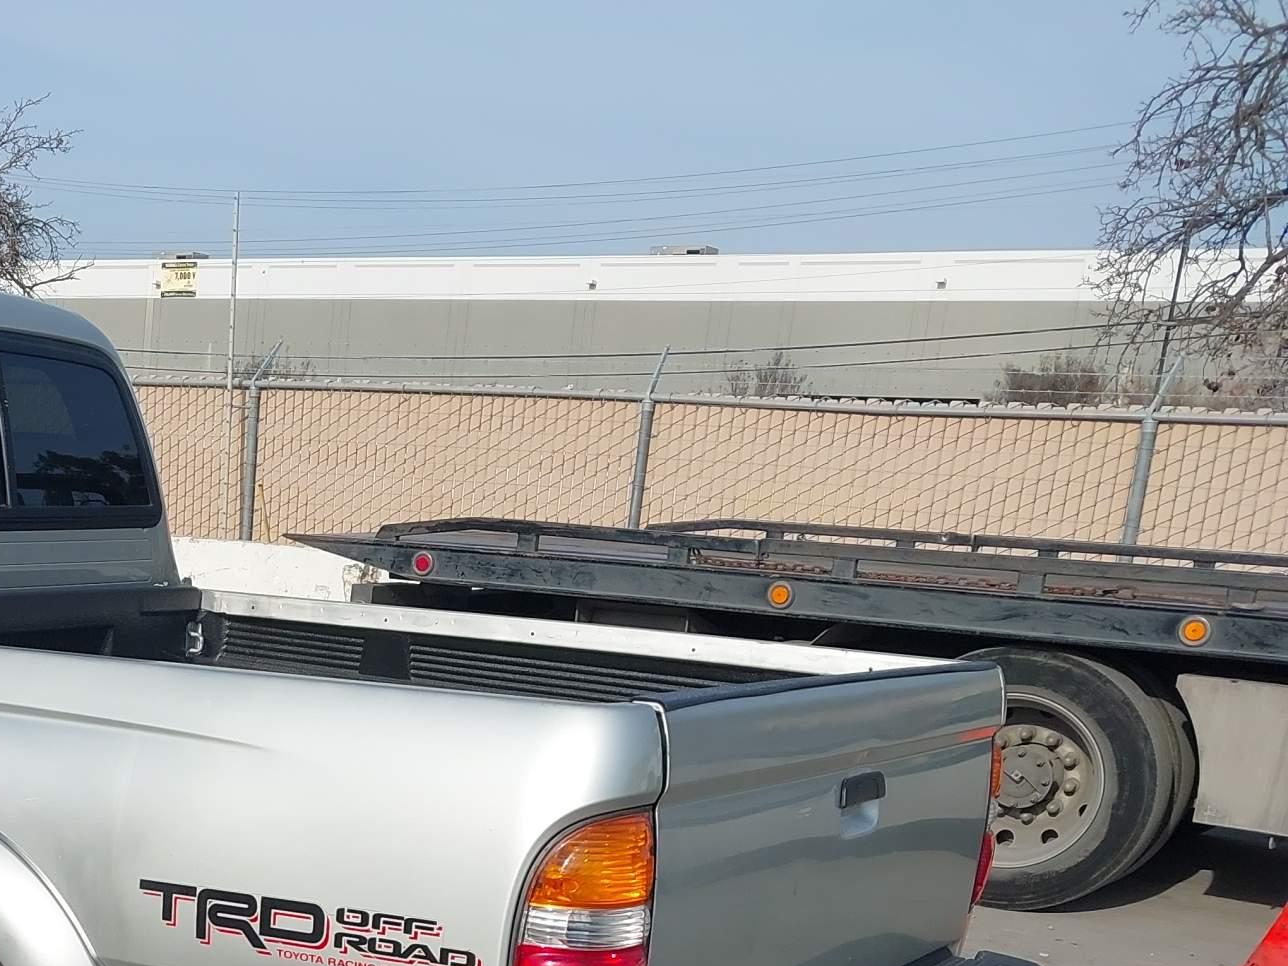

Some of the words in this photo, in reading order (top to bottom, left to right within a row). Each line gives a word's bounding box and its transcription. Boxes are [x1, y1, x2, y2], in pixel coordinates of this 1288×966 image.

[139, 878, 331, 956] TRD
[335, 907, 443, 939] OFF
[276, 948, 325, 966] TOYOTA
